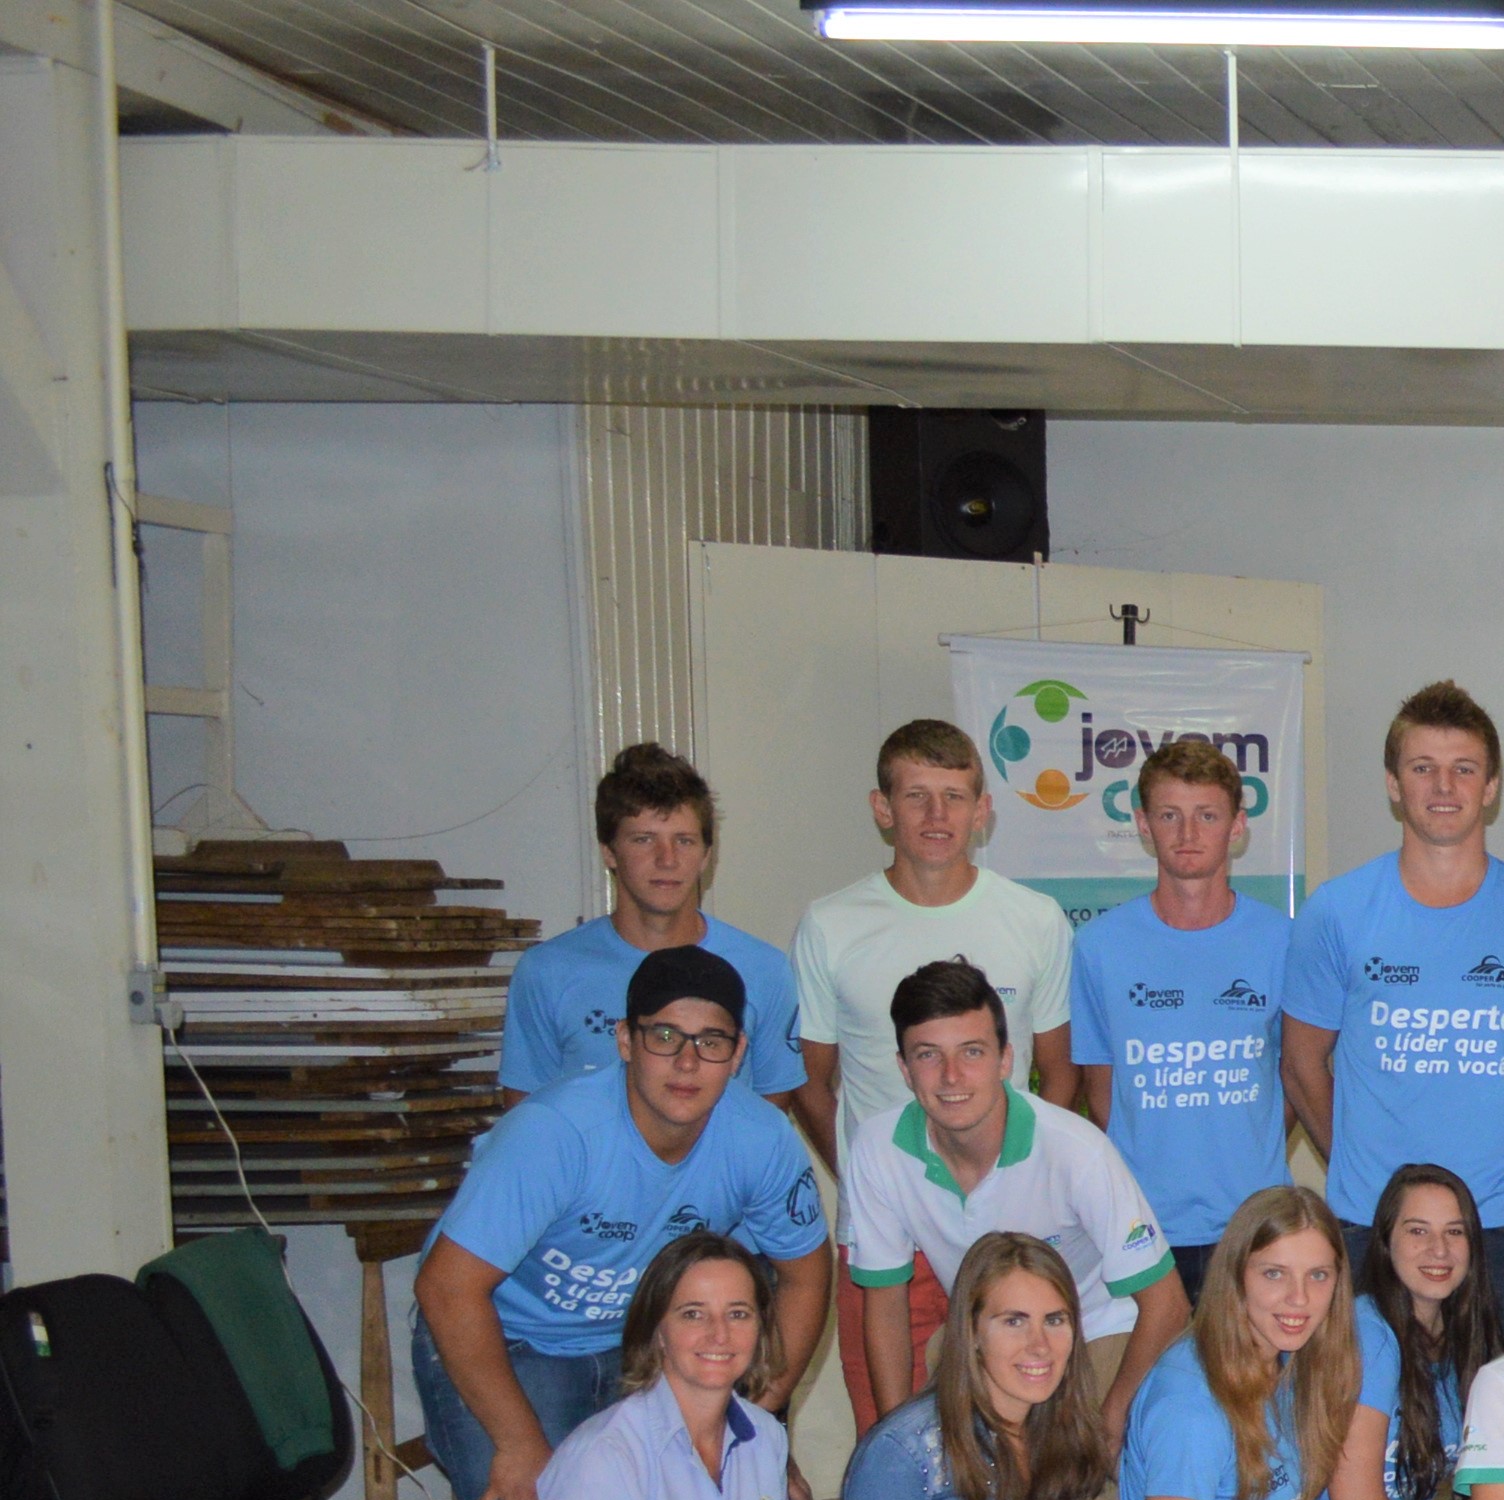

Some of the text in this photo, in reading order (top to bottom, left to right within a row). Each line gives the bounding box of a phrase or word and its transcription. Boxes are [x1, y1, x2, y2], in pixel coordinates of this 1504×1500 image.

[1075, 713, 1269, 781] jovm
[1381, 963, 1419, 979] jovem
[1385, 974, 1419, 985] coop
[1145, 987, 1184, 1001] jovem
[1150, 999, 1184, 1009] coop
[1248, 994, 1266, 1006] A1
[1126, 1035, 1264, 1069] Desperte
[1376, 1033, 1496, 1056] o líder que
[1381, 1054, 1407, 1072] há
[1415, 1060, 1449, 1074] em
[1135, 1067, 1249, 1088] o líder que
[1142, 1084, 1259, 1109] há em você
[595, 1217, 637, 1232] jovem
[599, 1231, 634, 1242] coop
[542, 1248, 646, 1291] Desp
[545, 1274, 632, 1305] o líder
[545, 1289, 624, 1320] há em
